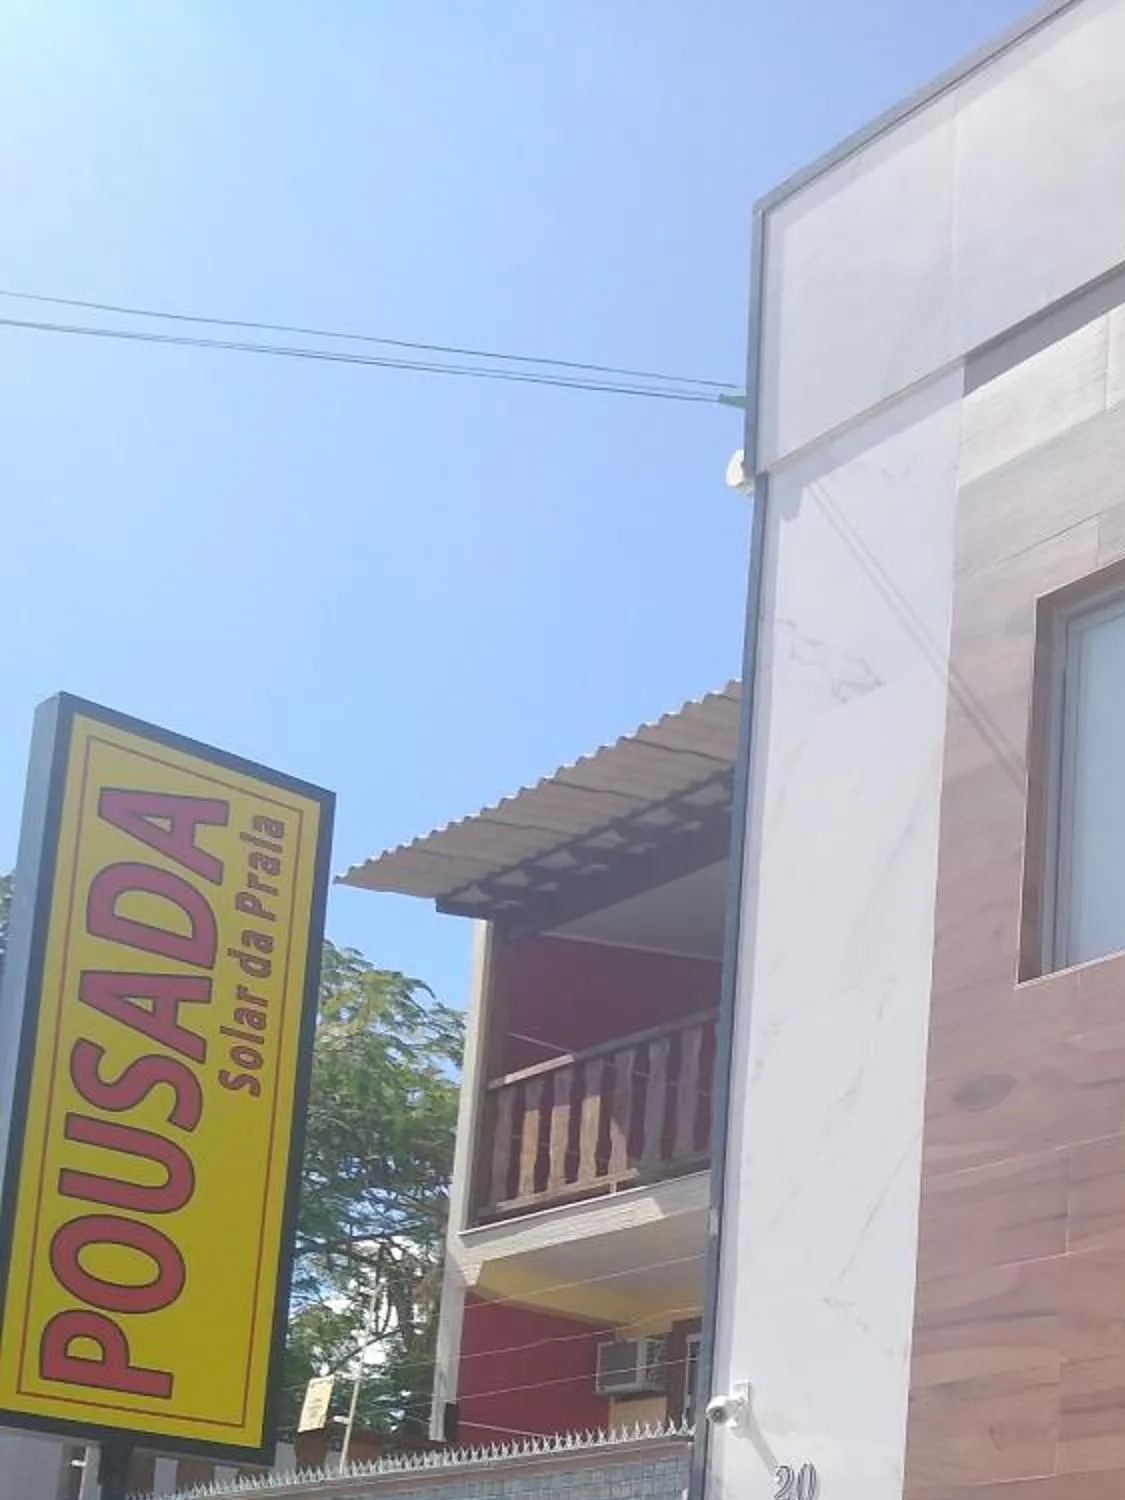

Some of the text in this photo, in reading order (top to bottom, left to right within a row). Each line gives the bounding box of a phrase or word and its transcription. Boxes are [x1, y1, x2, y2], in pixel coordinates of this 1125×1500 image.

[38, 786, 230, 1399] POUSADA
[218, 814, 286, 1097] Solar da Praia
